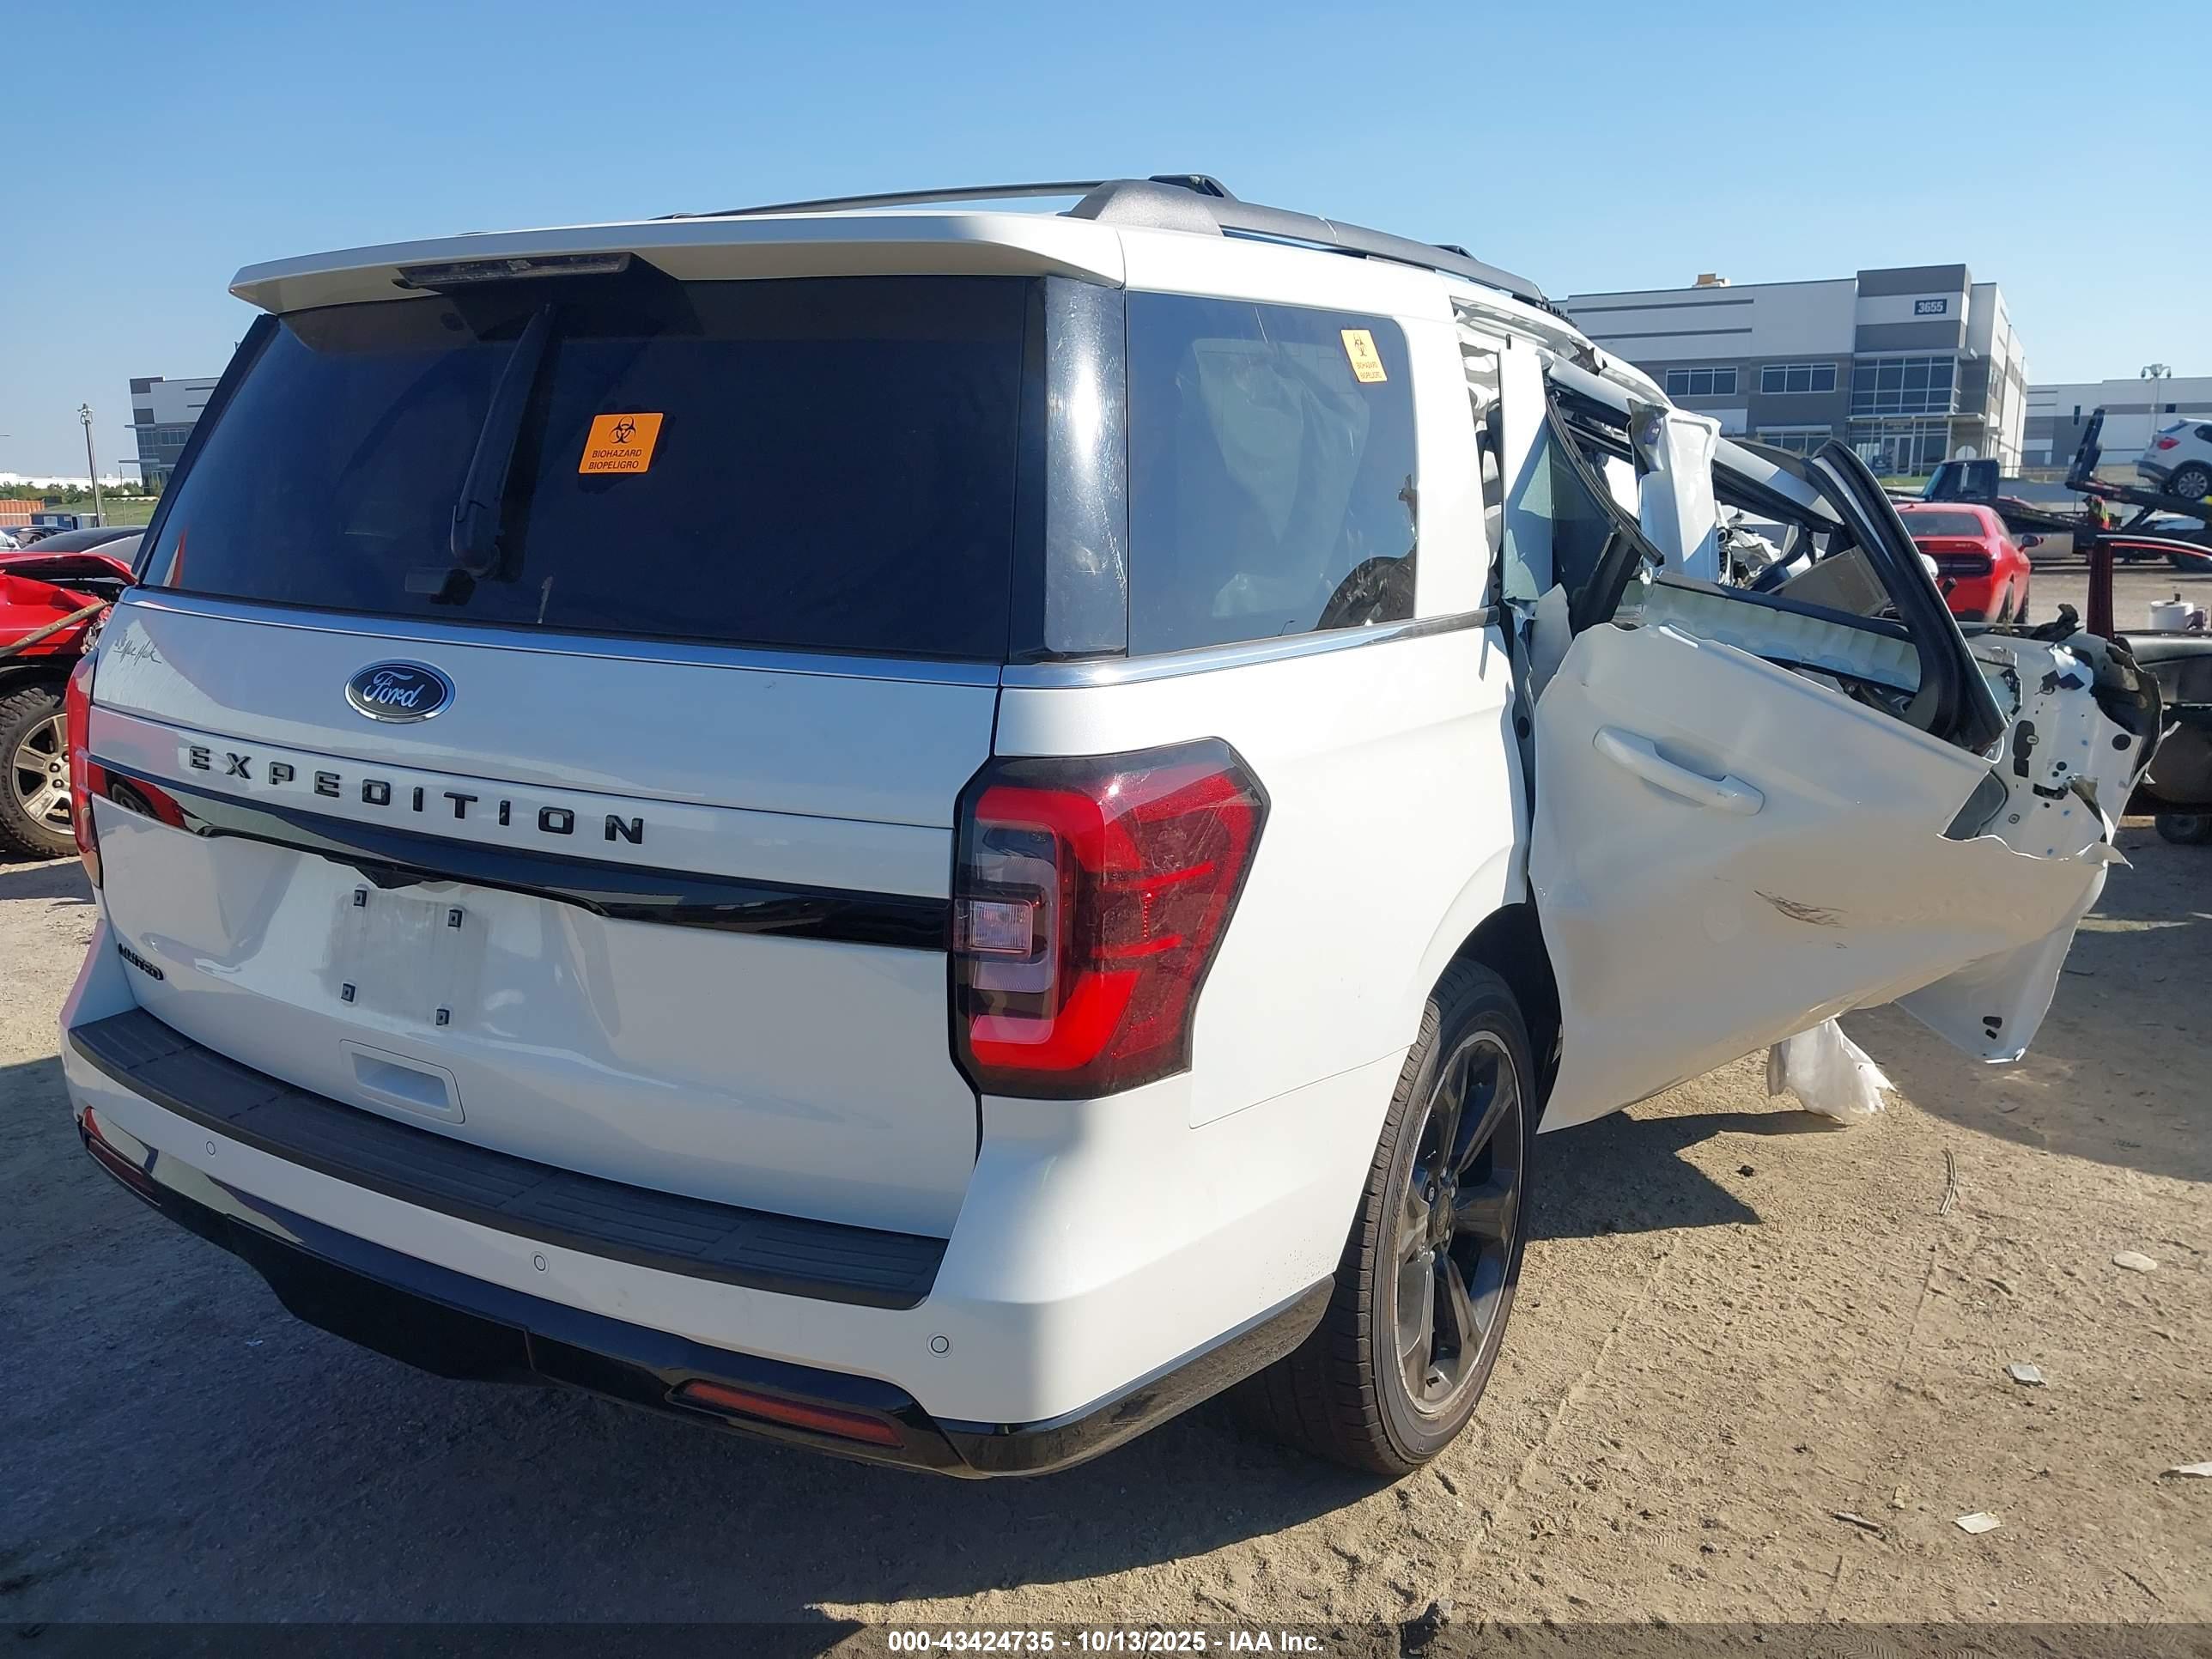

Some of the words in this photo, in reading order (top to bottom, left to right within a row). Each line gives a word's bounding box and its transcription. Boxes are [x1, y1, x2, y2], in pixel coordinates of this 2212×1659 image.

[1917, 301, 1944, 313] 3655
[591, 448, 643, 459] BIOHAZARD
[587, 459, 640, 471] BIOPELIGRO
[362, 670, 426, 708] Ford
[188, 744, 644, 846] EXPEDITION
